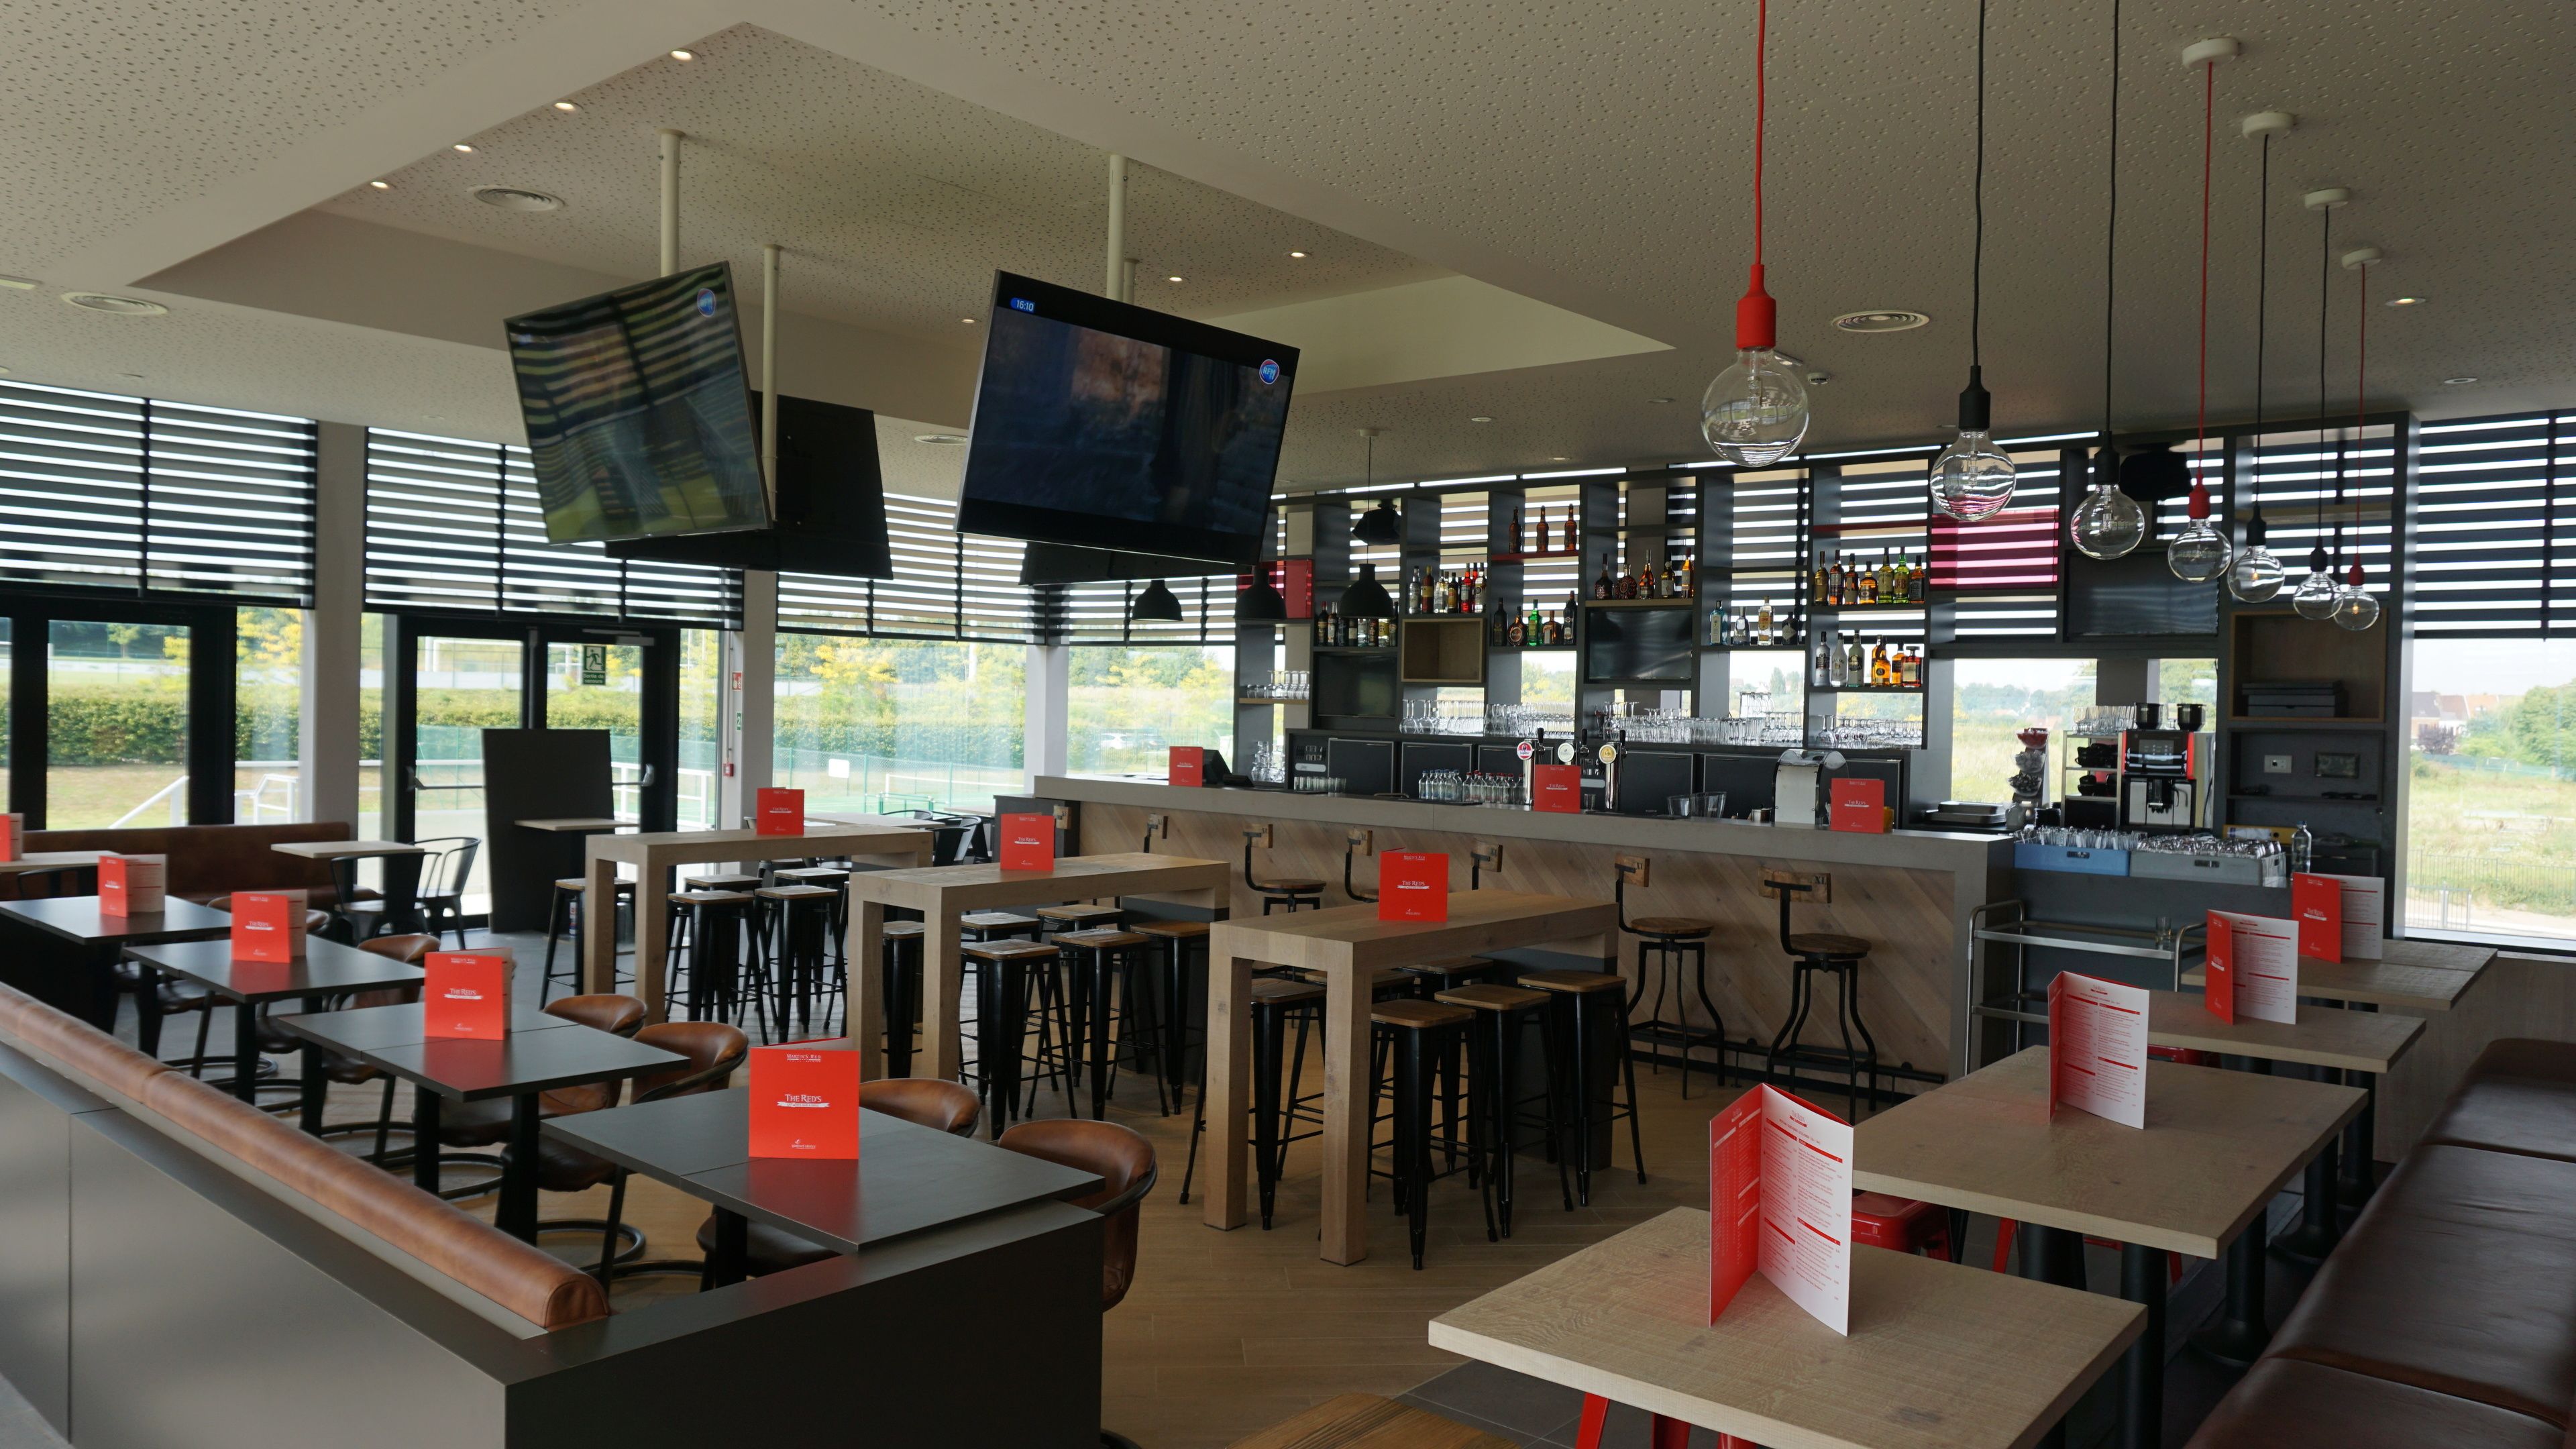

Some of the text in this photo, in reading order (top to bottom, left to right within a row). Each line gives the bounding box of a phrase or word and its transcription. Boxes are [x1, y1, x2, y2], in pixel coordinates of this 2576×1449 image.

[1016, 300, 1034, 311] 16:10
[1263, 366, 1276, 376] RFM
[737, 716, 741, 727] 2
[784, 1094, 822, 1103] THE RED'S
